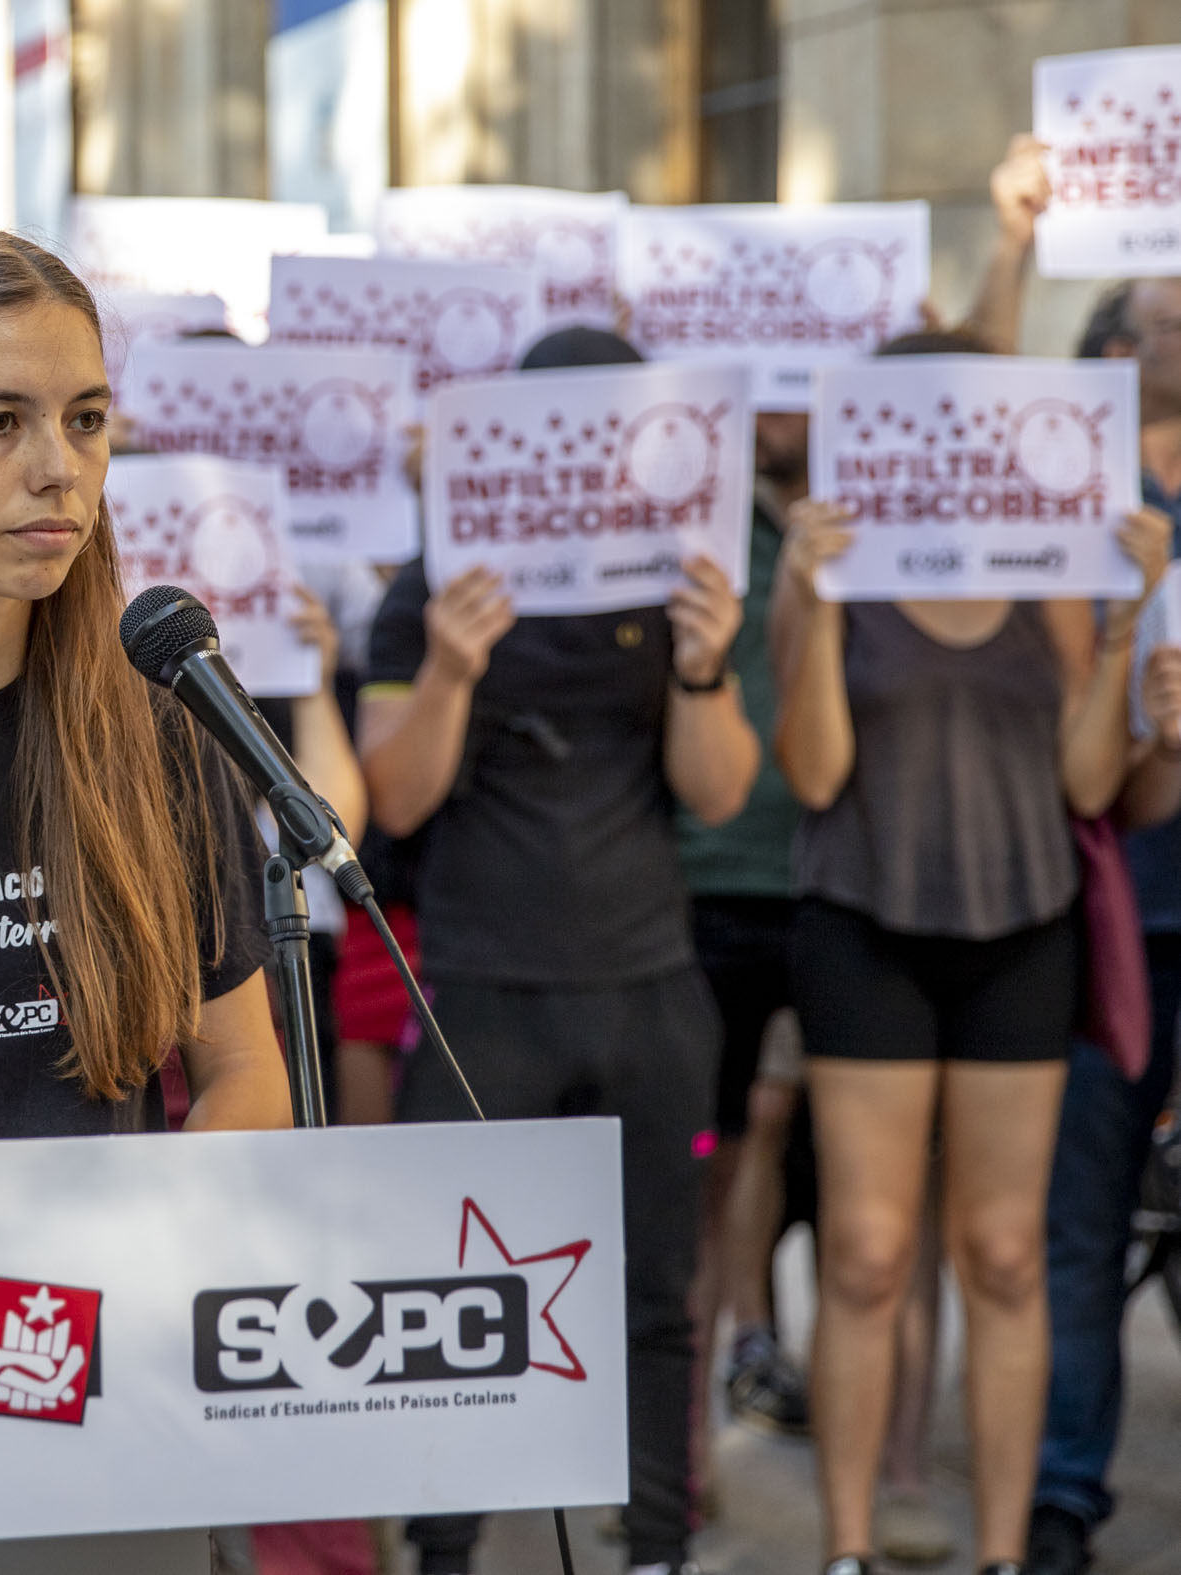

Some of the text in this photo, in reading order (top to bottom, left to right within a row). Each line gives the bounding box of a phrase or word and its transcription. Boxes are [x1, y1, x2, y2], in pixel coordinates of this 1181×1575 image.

[204, 1405, 266, 1421] Sindicat
[270, 1400, 360, 1417] d'Estudiants
[365, 1397, 396, 1411] dels
[454, 1391, 517, 1406] Catalans
